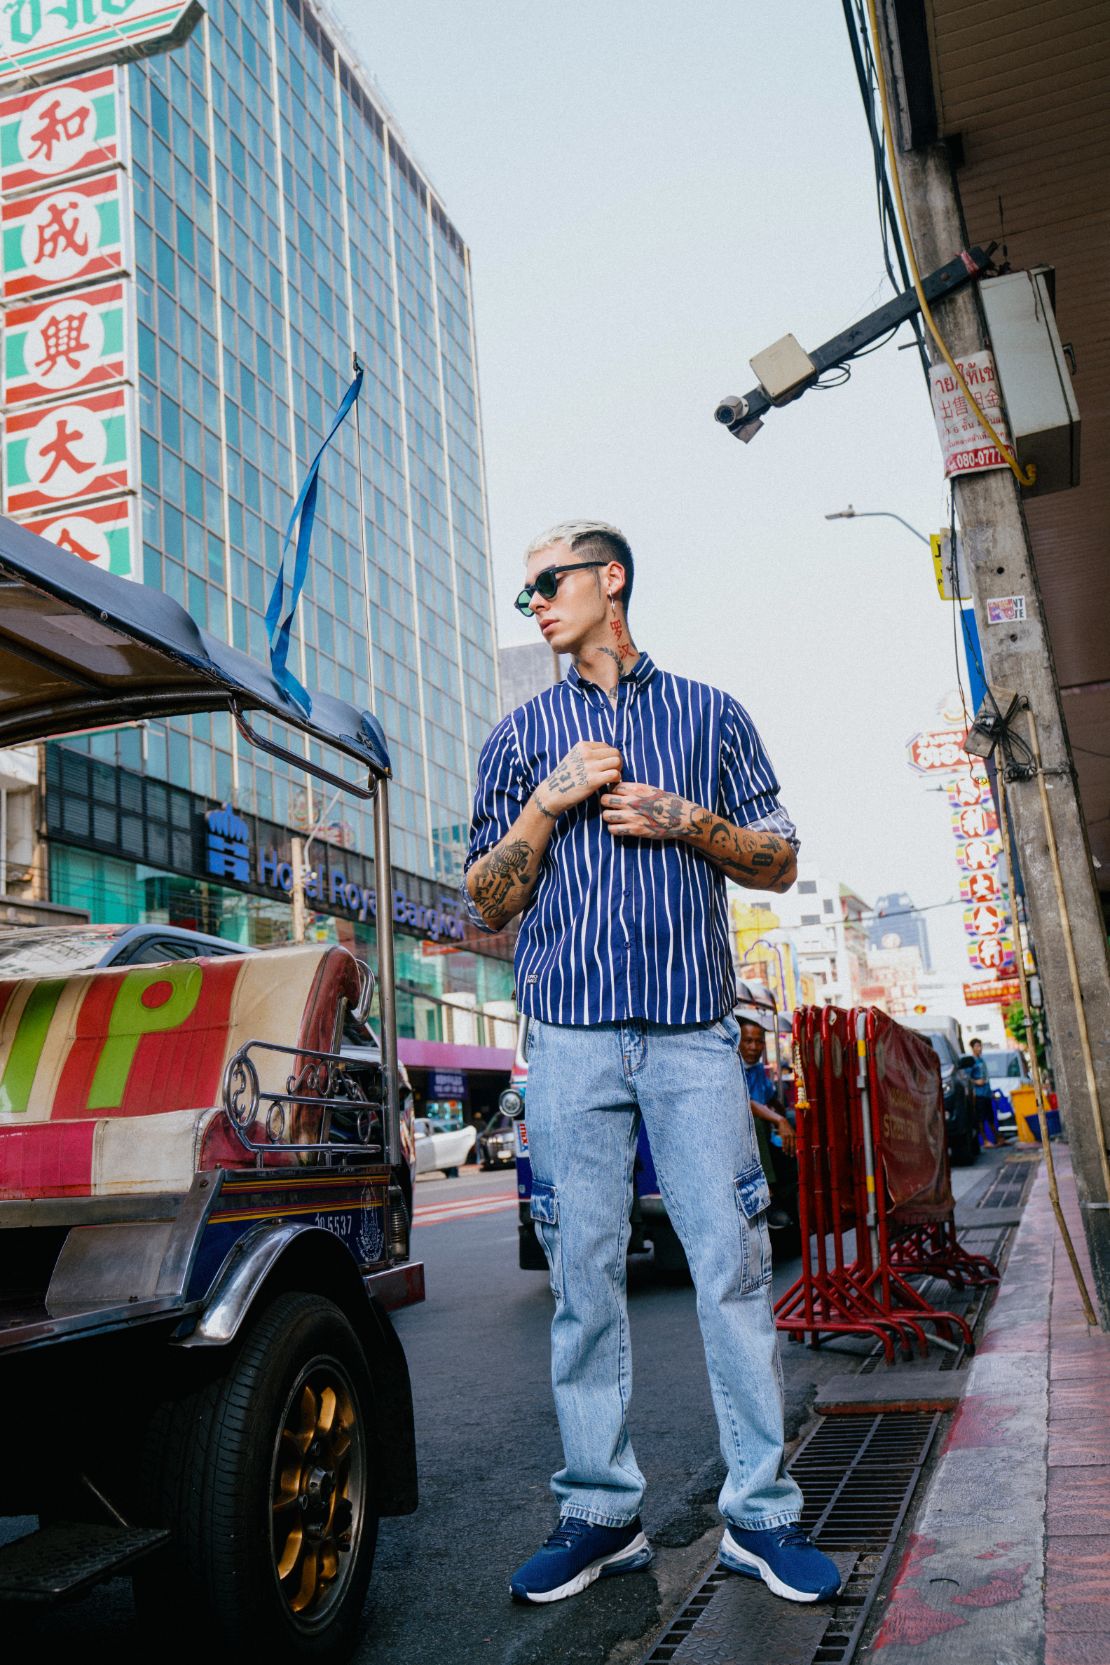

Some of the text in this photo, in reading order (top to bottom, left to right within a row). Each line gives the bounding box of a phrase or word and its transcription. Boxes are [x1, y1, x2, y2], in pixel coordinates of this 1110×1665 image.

[258, 847, 465, 941] Hoel Roya Bangkok
